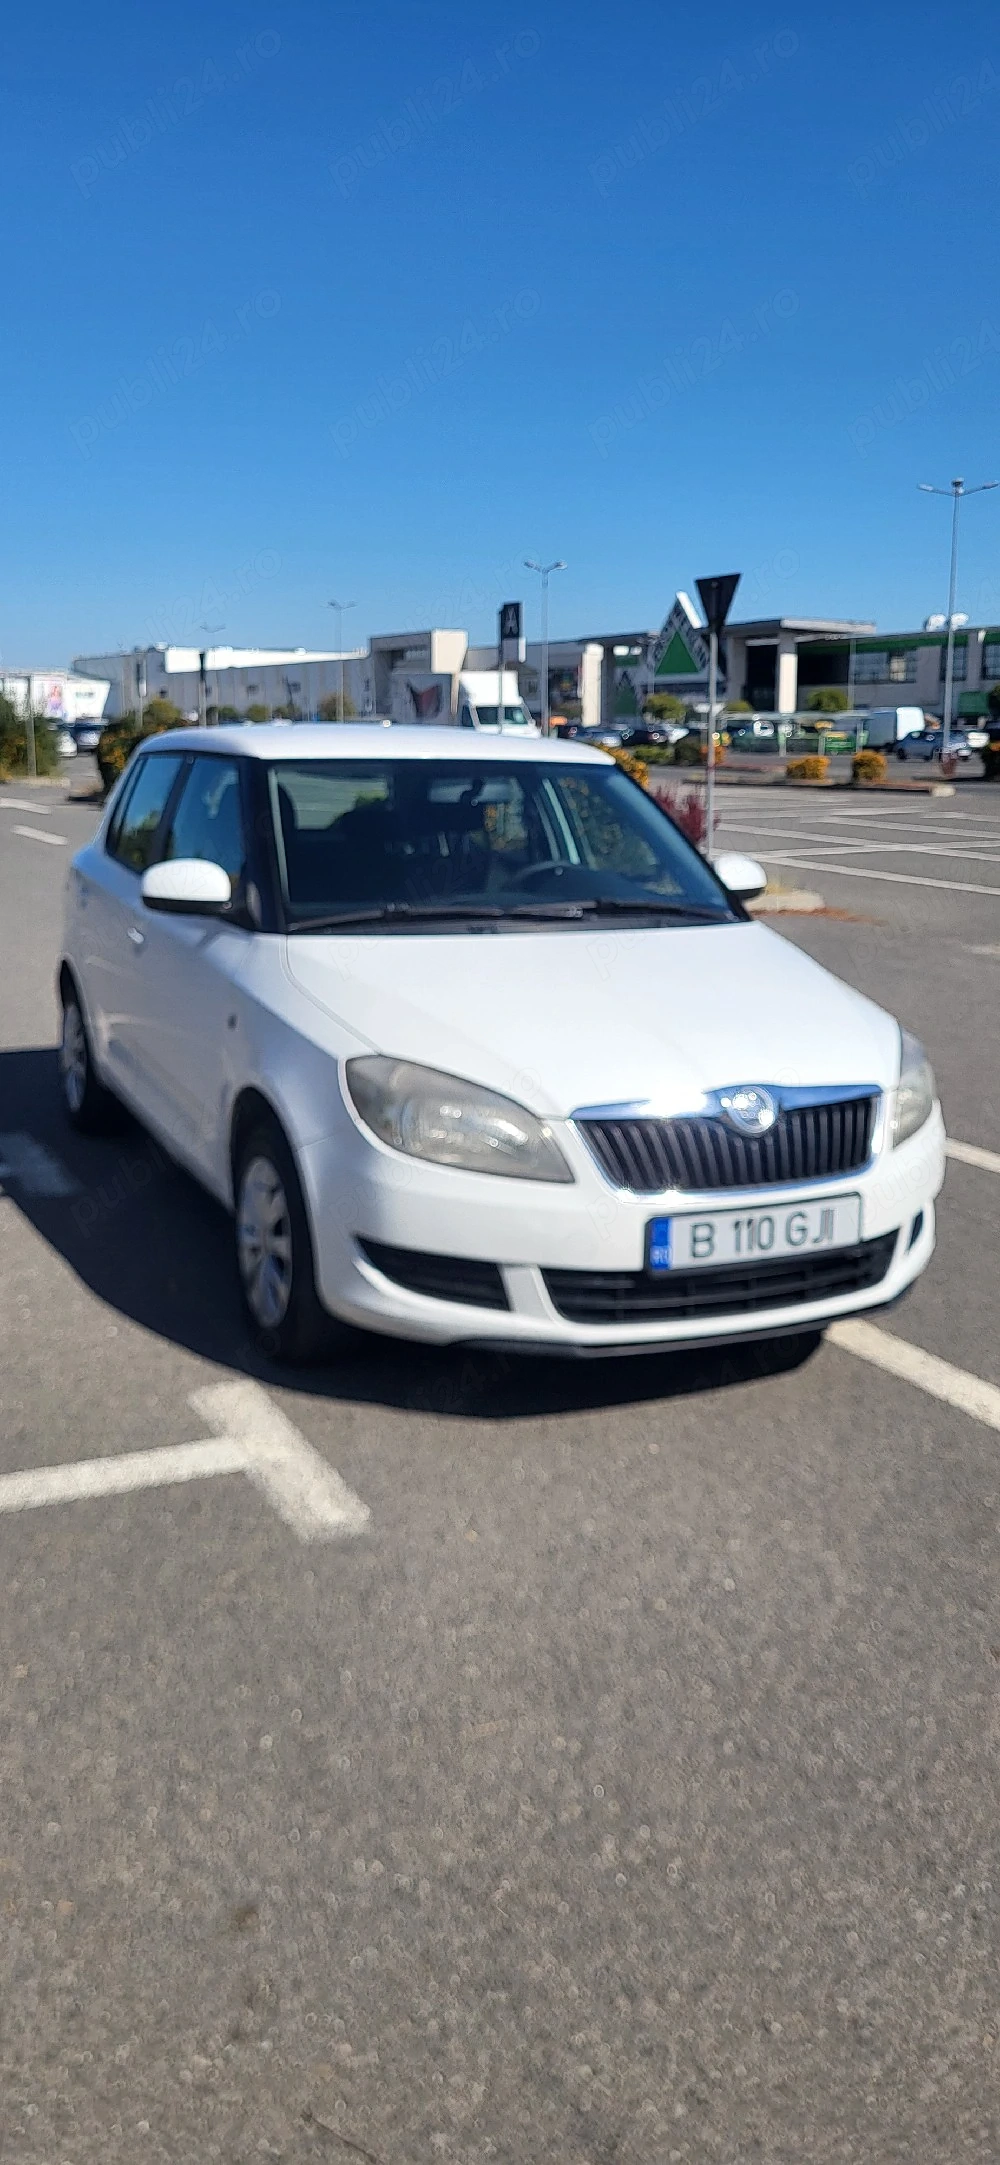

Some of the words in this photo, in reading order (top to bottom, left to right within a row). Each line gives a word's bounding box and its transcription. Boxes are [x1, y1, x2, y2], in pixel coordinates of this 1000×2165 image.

[691, 1222, 715, 1258] B
[734, 1216, 775, 1254] 110
[785, 1208, 834, 1247] GJI
